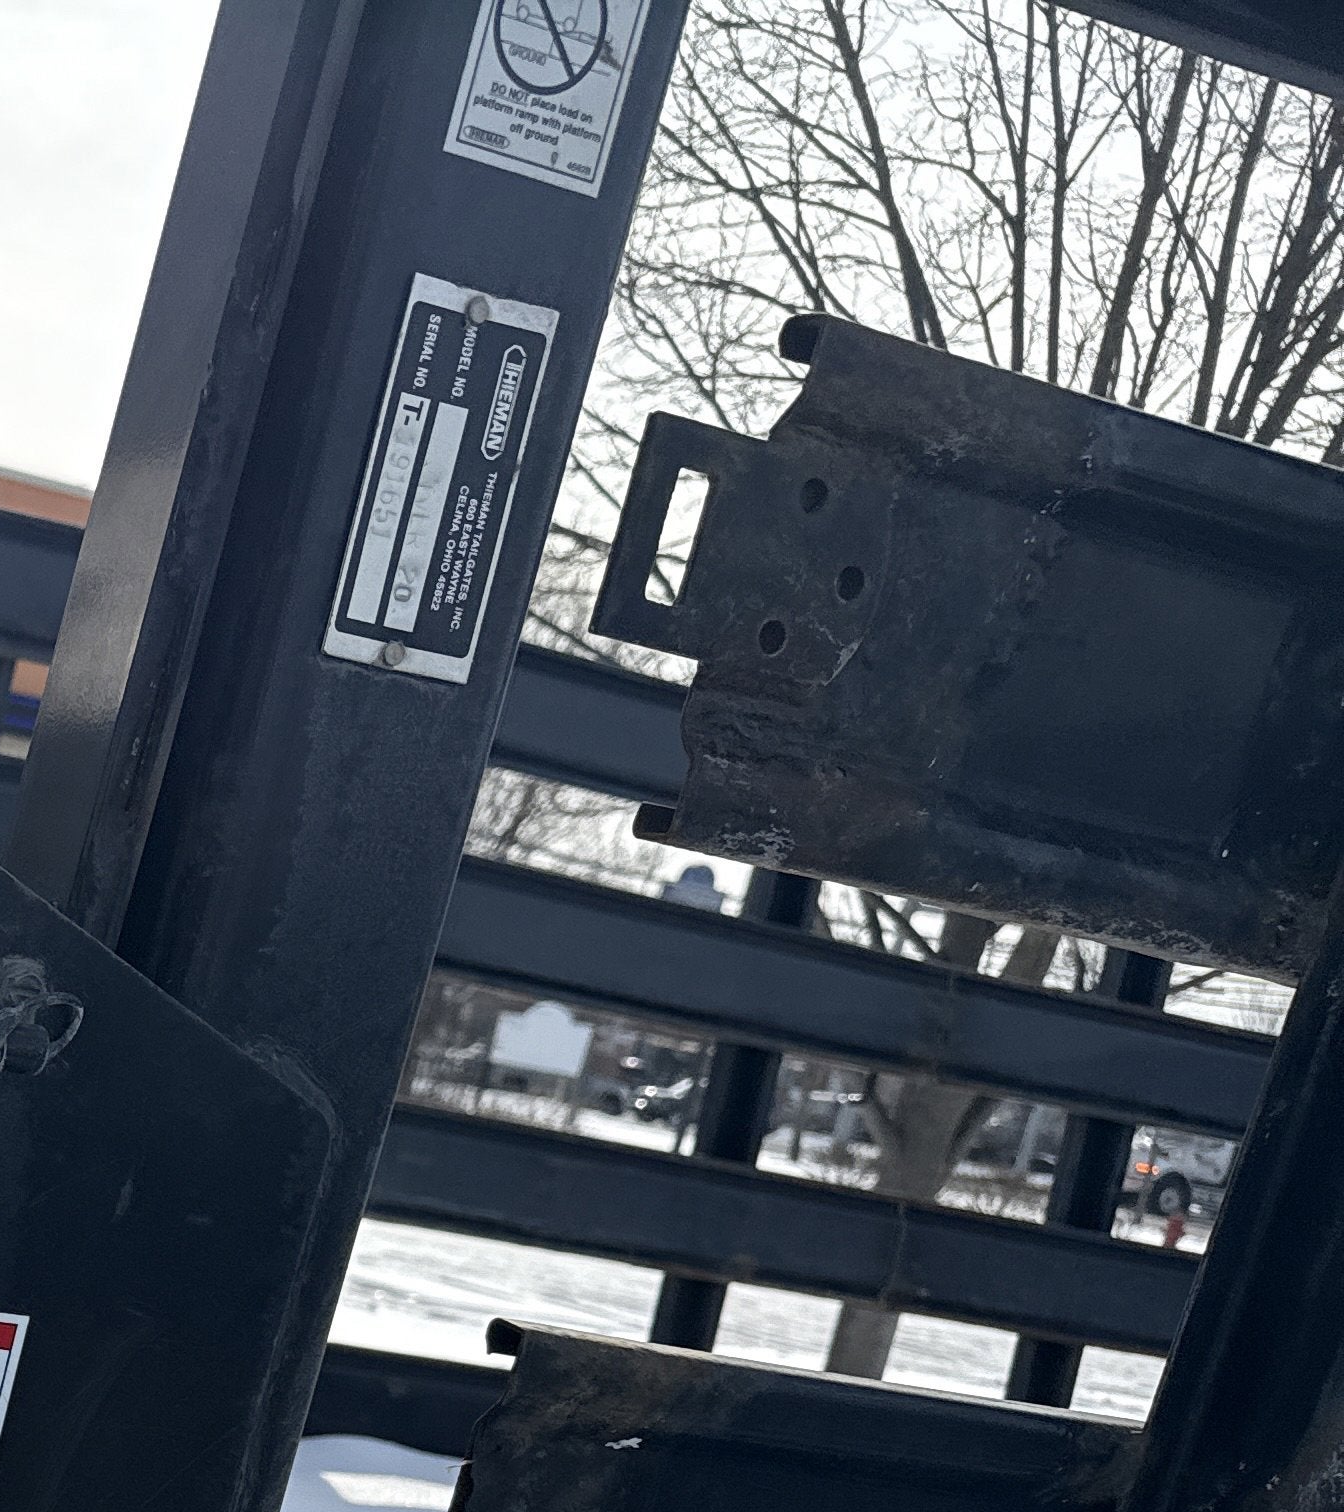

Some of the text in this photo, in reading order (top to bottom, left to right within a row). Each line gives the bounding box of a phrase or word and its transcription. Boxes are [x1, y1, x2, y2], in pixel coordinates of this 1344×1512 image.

[472, 93, 601, 143] platform ramp with platform
[490, 81, 593, 124] DO NOT place load on
[509, 122, 559, 147] off ground
[411, 312, 441, 390] SERIAL NO.
[449, 323, 478, 400] MODEL NO.
[484, 354, 526, 451] THIEMAN
[447, 484, 470, 536] CELINA,
[474, 471, 498, 530] THIEMAN
[439, 538, 456, 573] OHIO
[443, 497, 479, 604] 600 EAST WAYNE
[448, 605, 464, 633] INC.
